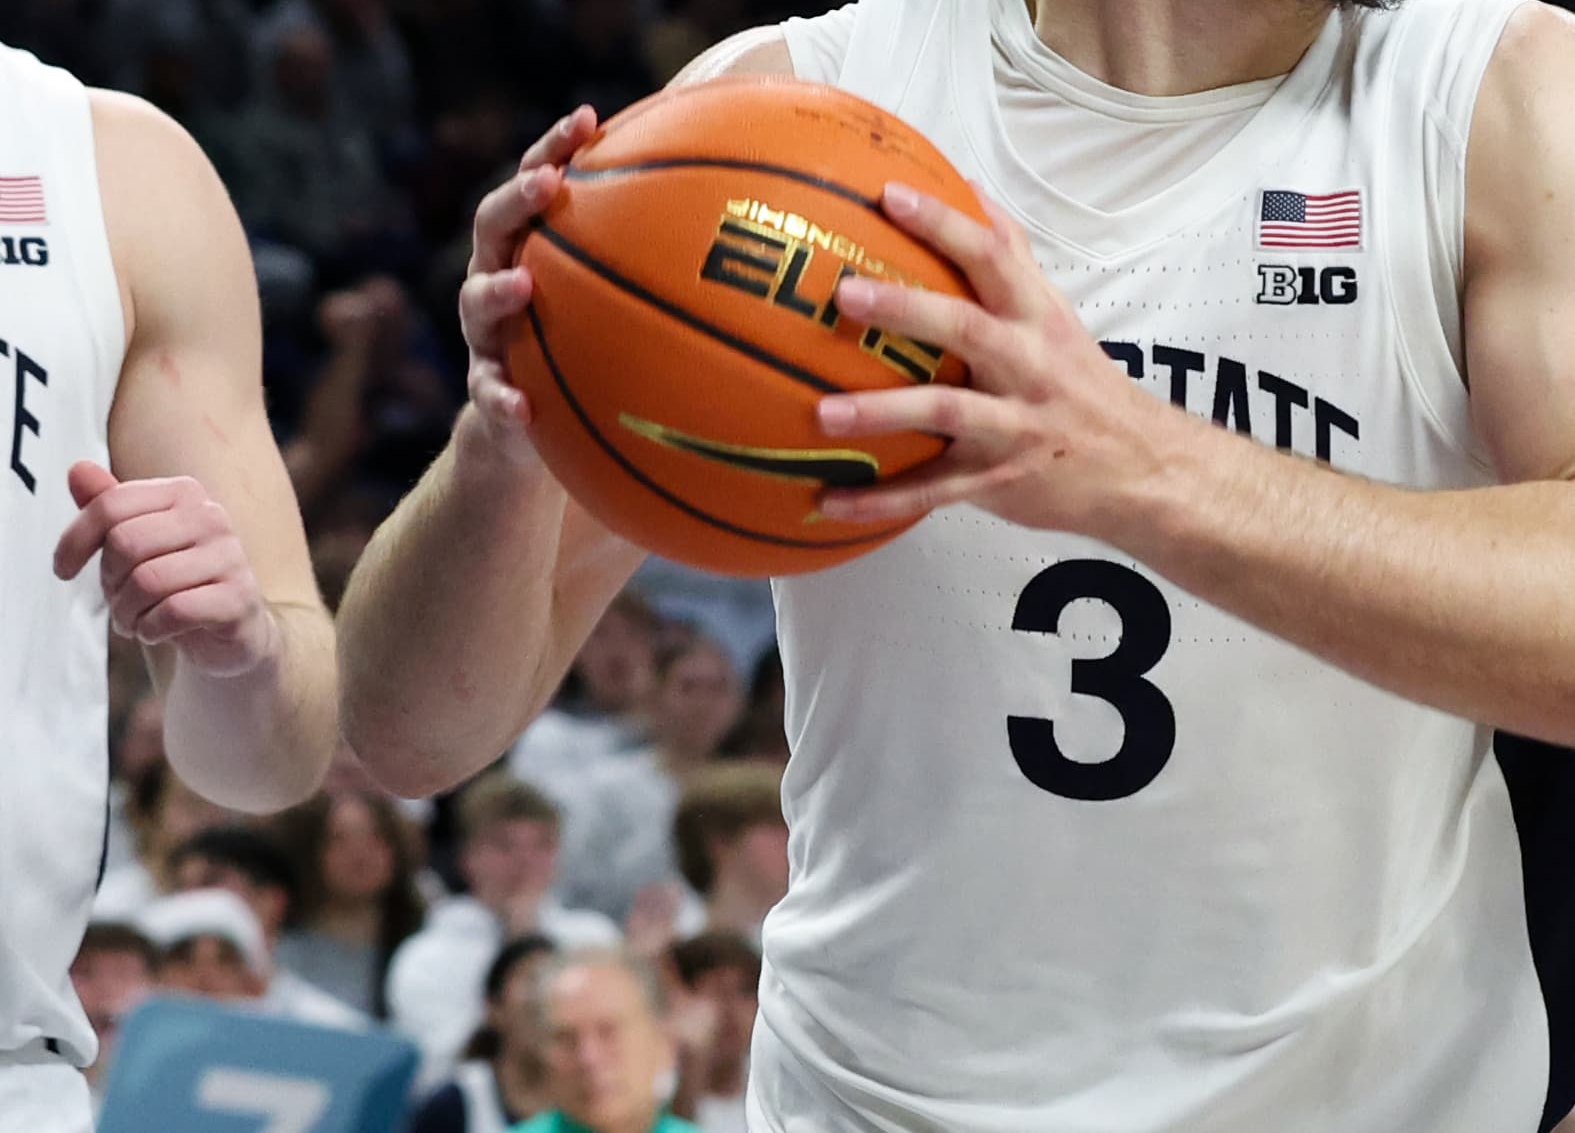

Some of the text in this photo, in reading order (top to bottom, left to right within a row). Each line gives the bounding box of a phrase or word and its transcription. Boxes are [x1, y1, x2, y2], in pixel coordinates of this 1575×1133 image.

[0, 236, 49, 267] 1G
[0, 339, 48, 494] E
[1006, 558, 1177, 803] 3
